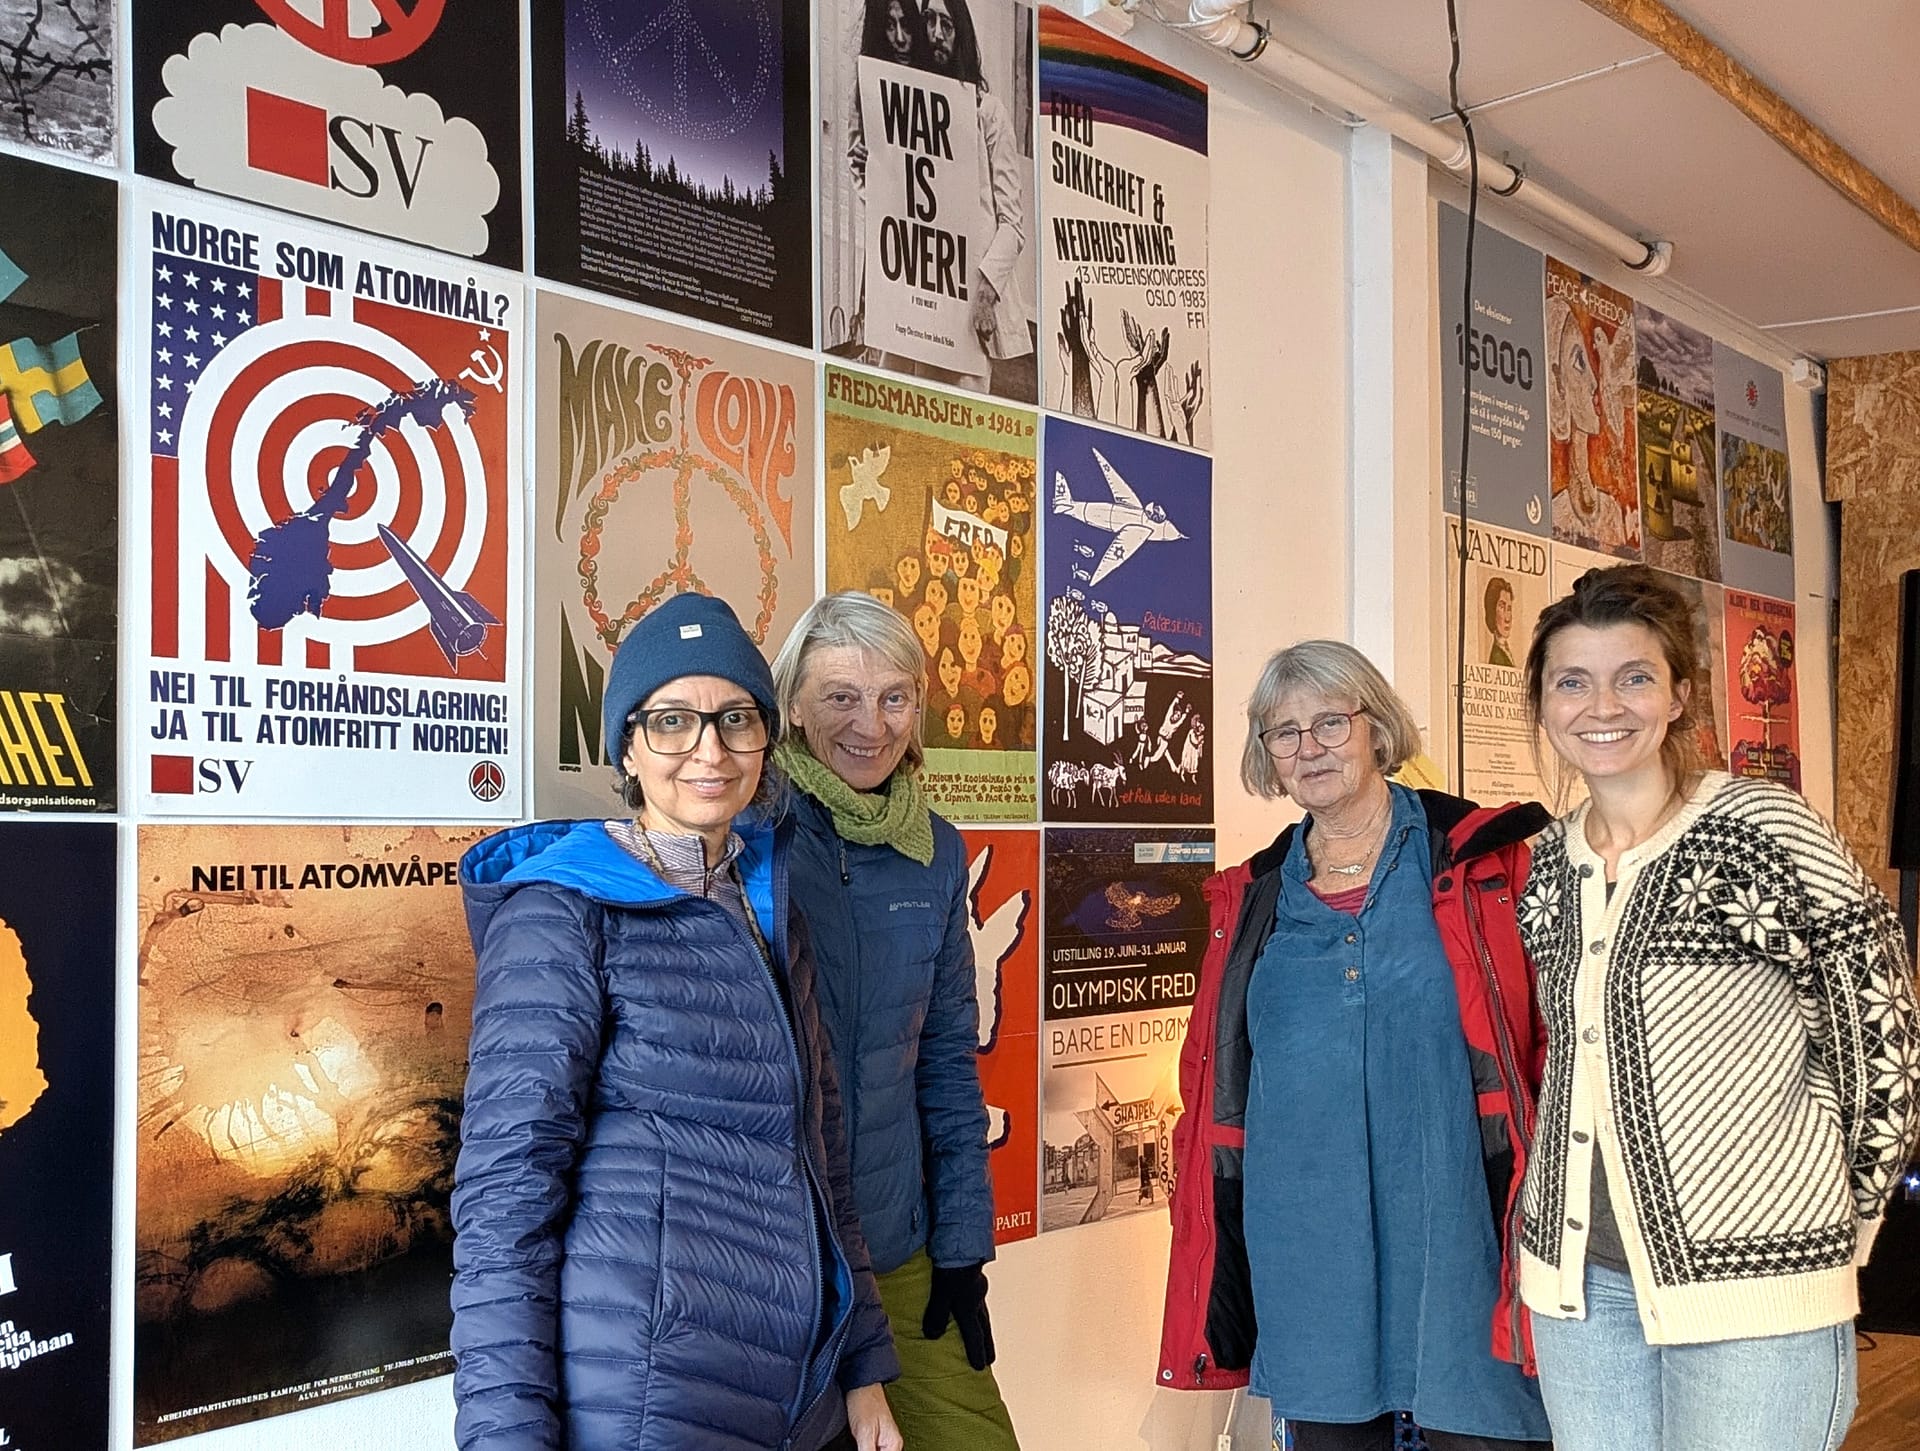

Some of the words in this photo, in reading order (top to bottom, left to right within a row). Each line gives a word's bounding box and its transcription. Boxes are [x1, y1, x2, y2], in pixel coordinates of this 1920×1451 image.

[880, 78, 954, 161] WAR
[1051, 91, 1093, 147] FRED
[329, 116, 434, 210] SV
[1052, 140, 1145, 217] SIKKERHET
[1153, 183, 1165, 224] &
[905, 152, 937, 223] IS
[880, 216, 968, 301] OVER!
[1052, 217, 1176, 266] NEDRUSTNING
[152, 211, 260, 271] NORGE
[276, 242, 344, 290] SOM
[355, 260, 510, 326] ATOMMÅL?
[1146, 289, 1176, 307] OSLO
[1179, 291, 1206, 308] 1983
[1187, 311, 1206, 329] FFI
[1547, 272, 1578, 304] PEACE
[1588, 290, 1633, 328] FREEDOM
[828, 372, 973, 429] FREDSMARSJEN
[988, 412, 1022, 437] 1981
[553, 332, 673, 543] MAKE
[695, 371, 797, 560] LOVE
[944, 516, 994, 549] FRED
[1451, 524, 1546, 576] WANTED
[150, 670, 195, 704] NEI
[210, 674, 252, 708] TIL
[266, 674, 508, 722] FORHÅNDSLAGRING!
[1452, 684, 1472, 698] TE
[1474, 686, 1498, 702] MOST
[1463, 664, 1493, 686] JANE
[1495, 670, 1525, 689] ADDA
[151, 709, 188, 740] JA
[202, 711, 243, 742] TIL
[256, 714, 402, 750] ATOMFRITT
[413, 723, 508, 754] NORDEN!
[1496, 706, 1504, 718] IN
[0, 691, 94, 786] HET
[198, 758, 255, 794] SV
[1180, 792, 1202, 806] land
[192, 865, 244, 892] NEI
[251, 865, 294, 890] TIL
[298, 854, 458, 890] ATOMVÅPE
[1053, 946, 1102, 962] UTSTILLING
[1104, 948, 1116, 959] 19.
[1154, 941, 1187, 955] JANUAR
[1052, 976, 1147, 1010] OLYMPISK
[1152, 972, 1196, 1000] FRED
[1052, 1026, 1104, 1056] BARE
[1110, 1022, 1134, 1048] EN
[1140, 1016, 1189, 1045] DRØM
[996, 1211, 1032, 1231] PARTI
[270, 1380, 312, 1398] KAMPANJE
[314, 1379, 328, 1388] FOR
[329, 1366, 380, 1384] NEDRUSTNING
[416, 1350, 453, 1364] YOUNGSTO
[298, 1391, 319, 1402] ALVA
[320, 1384, 354, 1396] MYRDAL
[356, 1376, 385, 1388] FONDET
